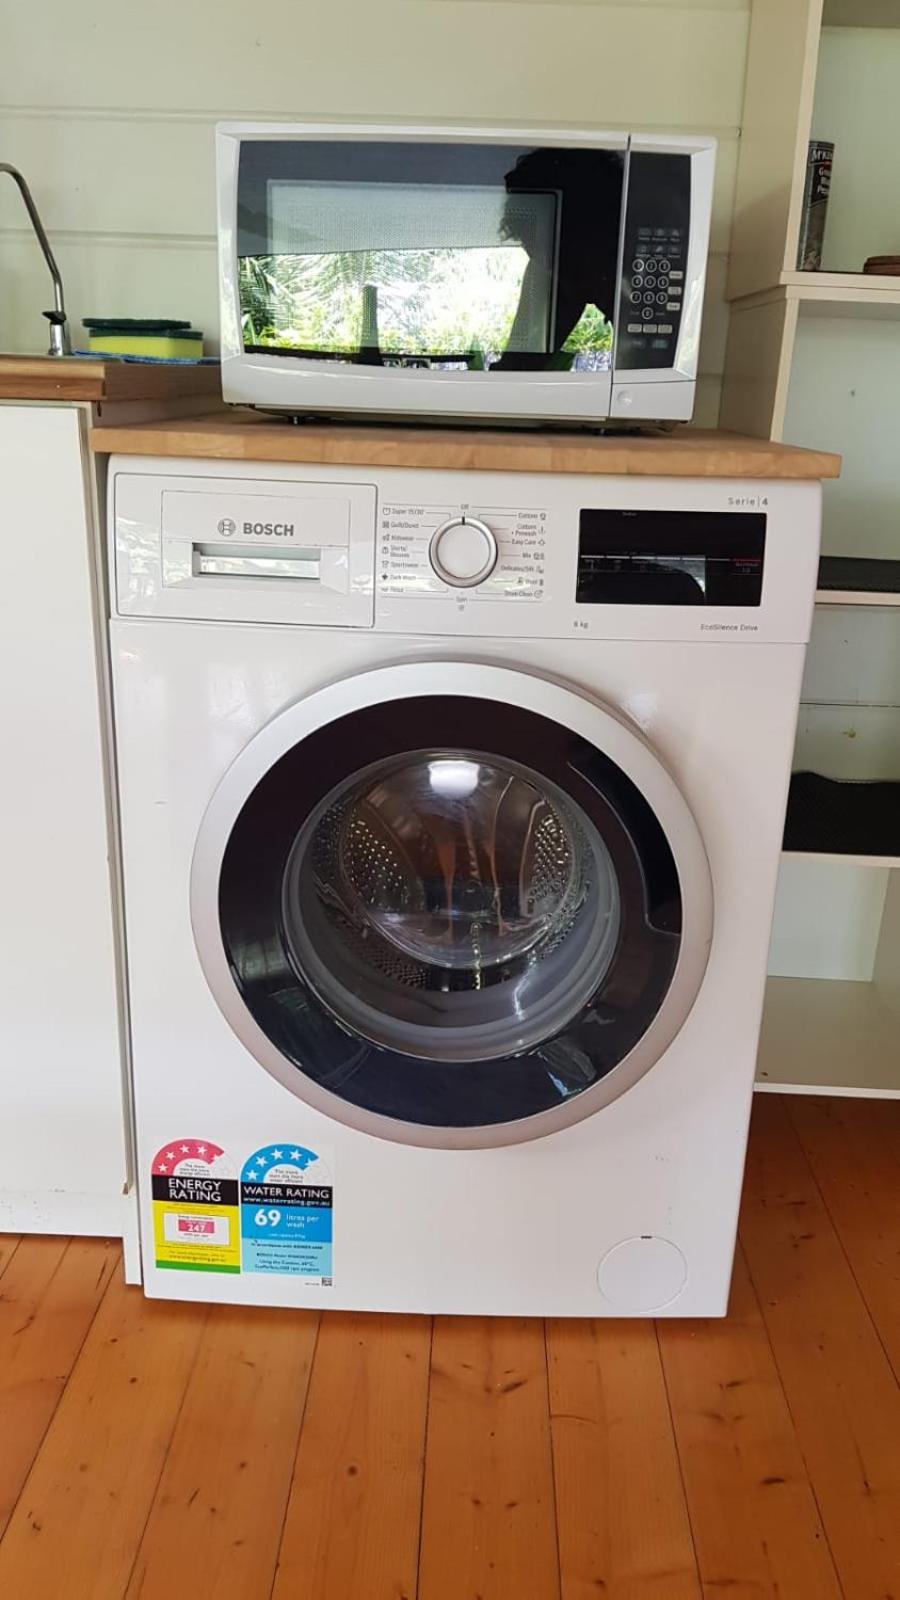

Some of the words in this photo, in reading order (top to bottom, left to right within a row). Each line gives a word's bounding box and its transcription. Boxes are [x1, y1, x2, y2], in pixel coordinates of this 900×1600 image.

[728, 497, 756, 506] Serie
[243, 522, 294, 536] BOSCH
[168, 1178, 221, 1191] ENERGY
[169, 1189, 221, 1202] RATING
[243, 1186, 283, 1196] WATER
[286, 1188, 329, 1199] RATING
[243, 1197, 330, 1206] www.waterrating.gov.au
[254, 1208, 281, 1227] 69
[286, 1213, 304, 1221] litres
[306, 1215, 319, 1223] per
